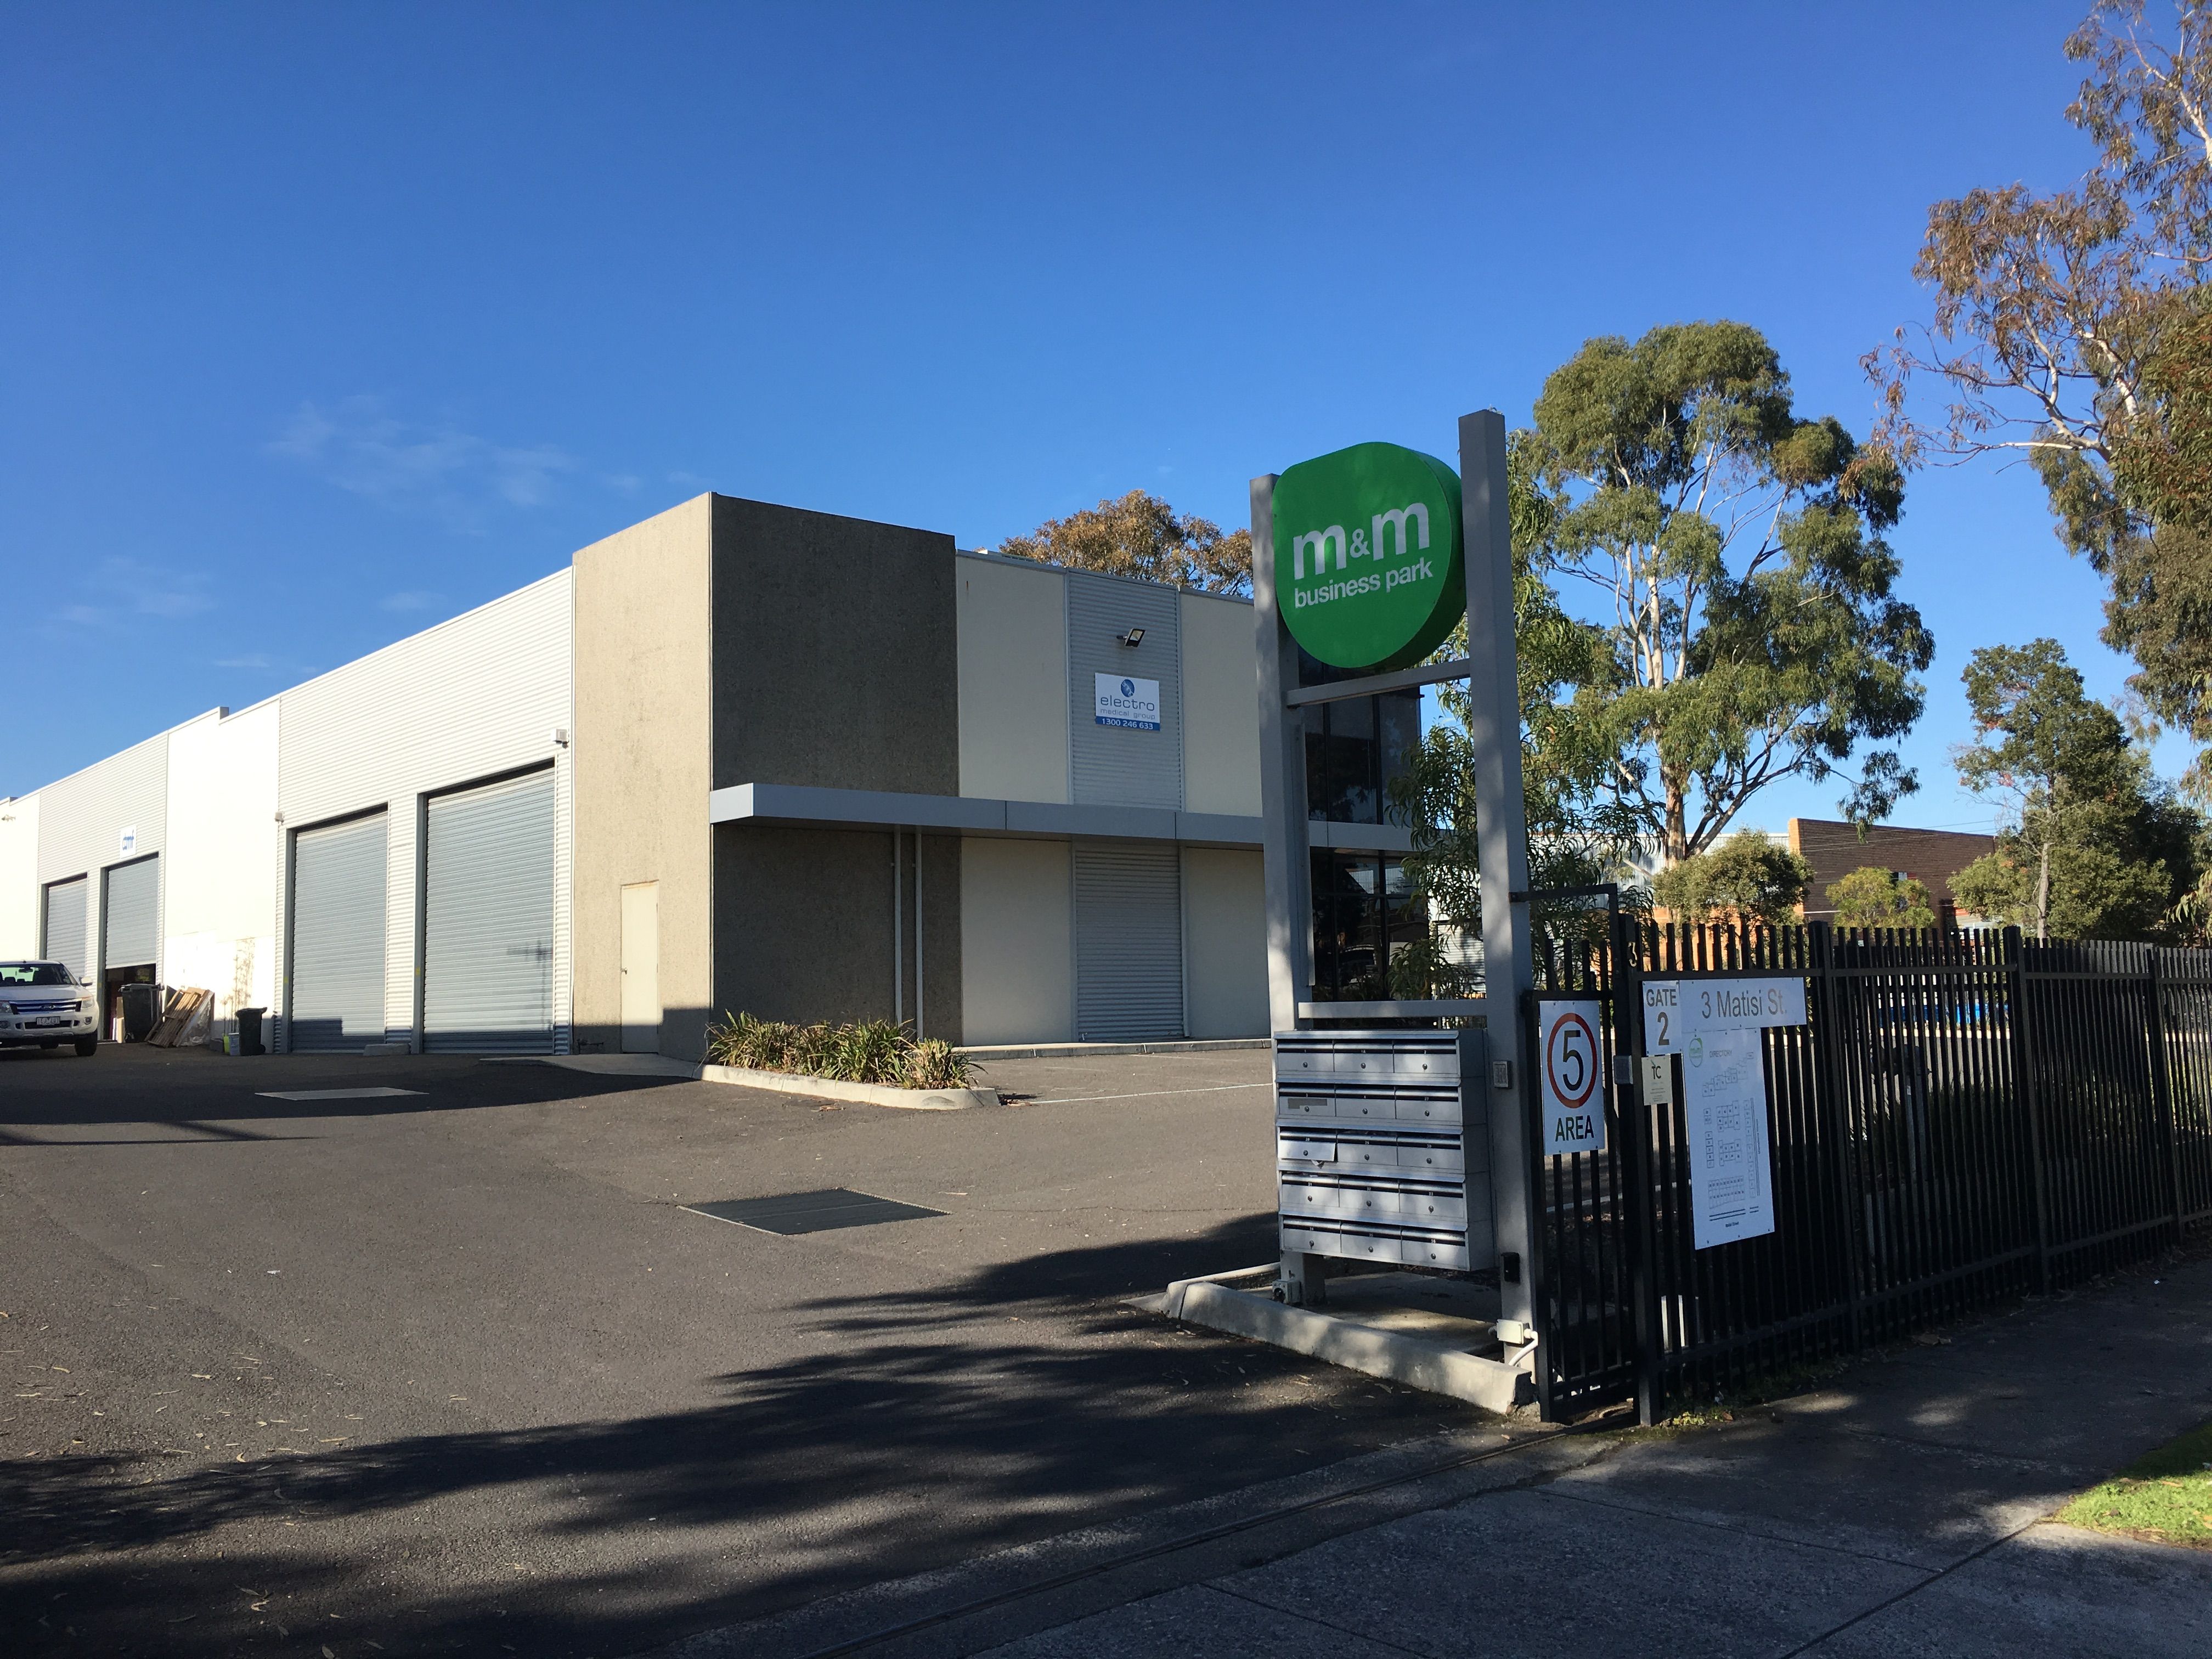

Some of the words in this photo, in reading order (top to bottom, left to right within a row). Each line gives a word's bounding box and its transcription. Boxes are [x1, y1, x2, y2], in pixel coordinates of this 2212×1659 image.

[1293, 503, 1430, 580] m&m
[1295, 574, 1380, 608] business
[1386, 557, 1434, 592] park
[1100, 695, 1155, 712] electro
[1100, 708, 1129, 716] medical
[1102, 718, 1121, 726] 1300
[1646, 989, 1677, 1007] GATE
[1701, 993, 1712, 1019] 3
[1717, 990, 1763, 1018] Matisi
[1767, 988, 1787, 1015] St.
[1657, 1012, 1670, 1046] 2
[1562, 1030, 1584, 1091] 5
[1708, 1049, 1733, 1058] DIRECTORY
[1555, 1115, 1594, 1142] AREA
